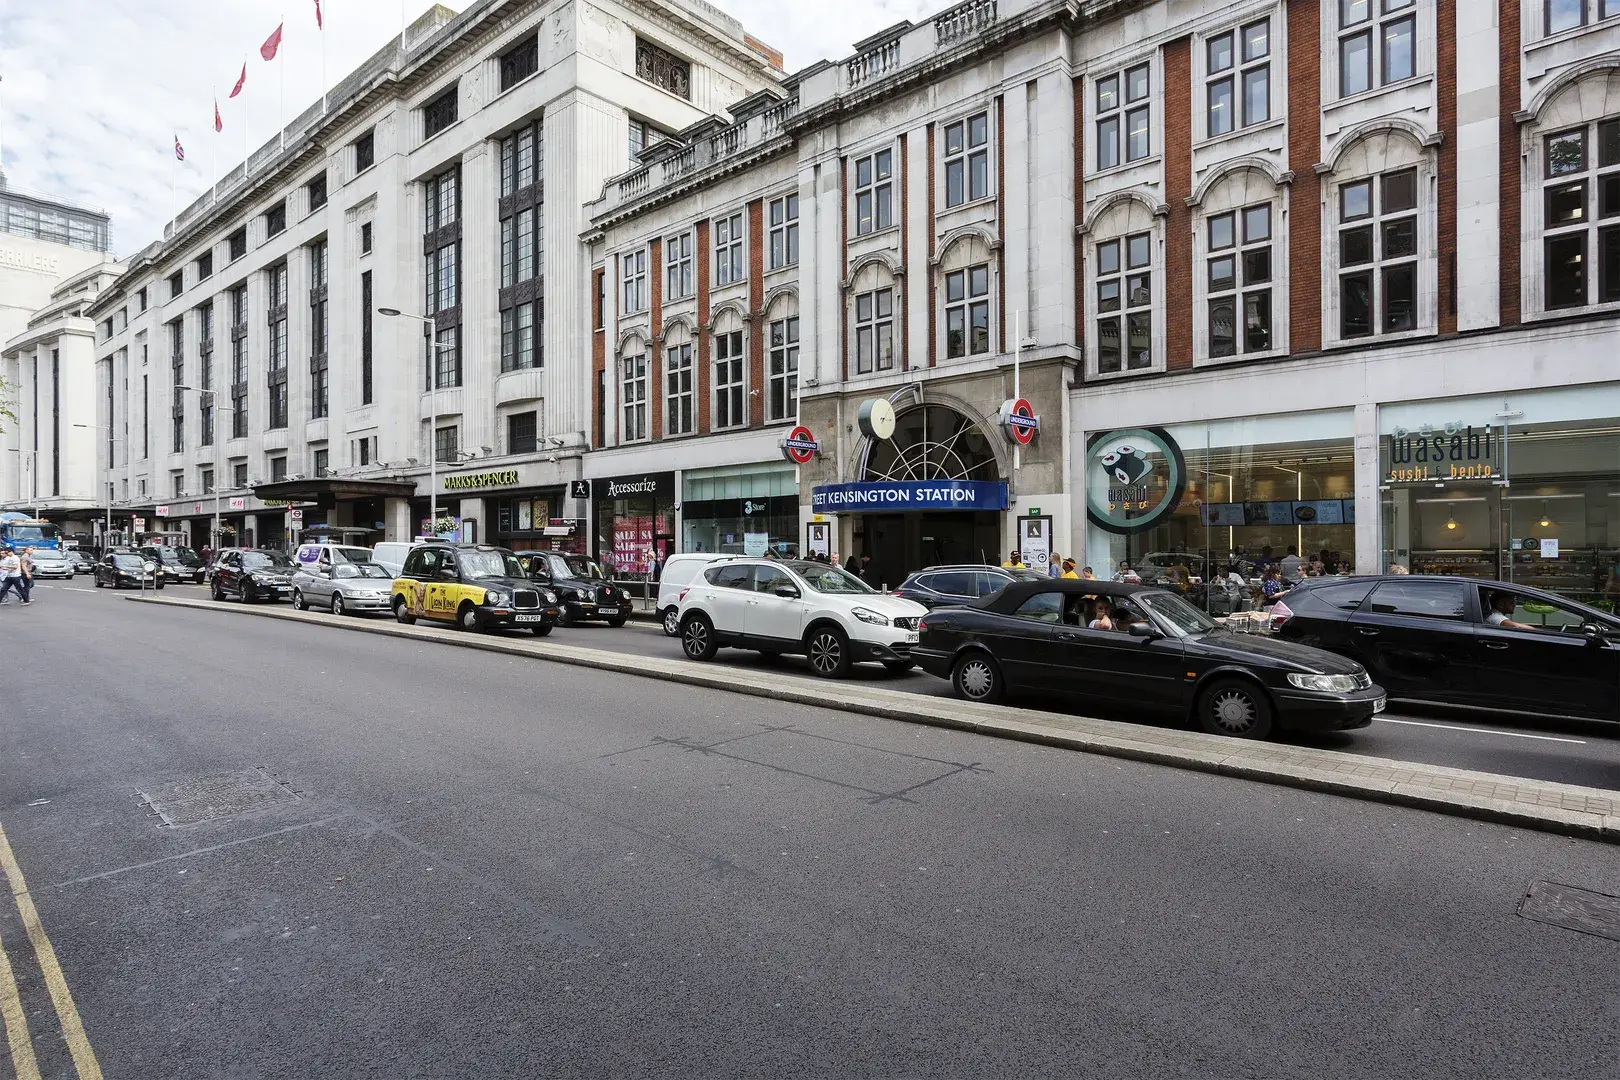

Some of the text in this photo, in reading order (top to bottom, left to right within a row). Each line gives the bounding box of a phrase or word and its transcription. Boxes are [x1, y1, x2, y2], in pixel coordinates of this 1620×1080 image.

[1010, 416, 1036, 426] UNDERGROUND
[787, 440, 817, 449] UNDERGROUND
[1392, 423, 1490, 464] wasabi
[1391, 466, 1428, 480] sushi
[1451, 464, 1491, 477] bento
[607, 477, 656, 497] Accessorize
[1108, 484, 1147, 501] wasabi
[828, 489, 910, 504] KENSINGTON
[916, 489, 975, 502] STATION
[615, 531, 636, 540] SALE
[615, 542, 636, 551] SALE
[615, 553, 636, 562] SALE
